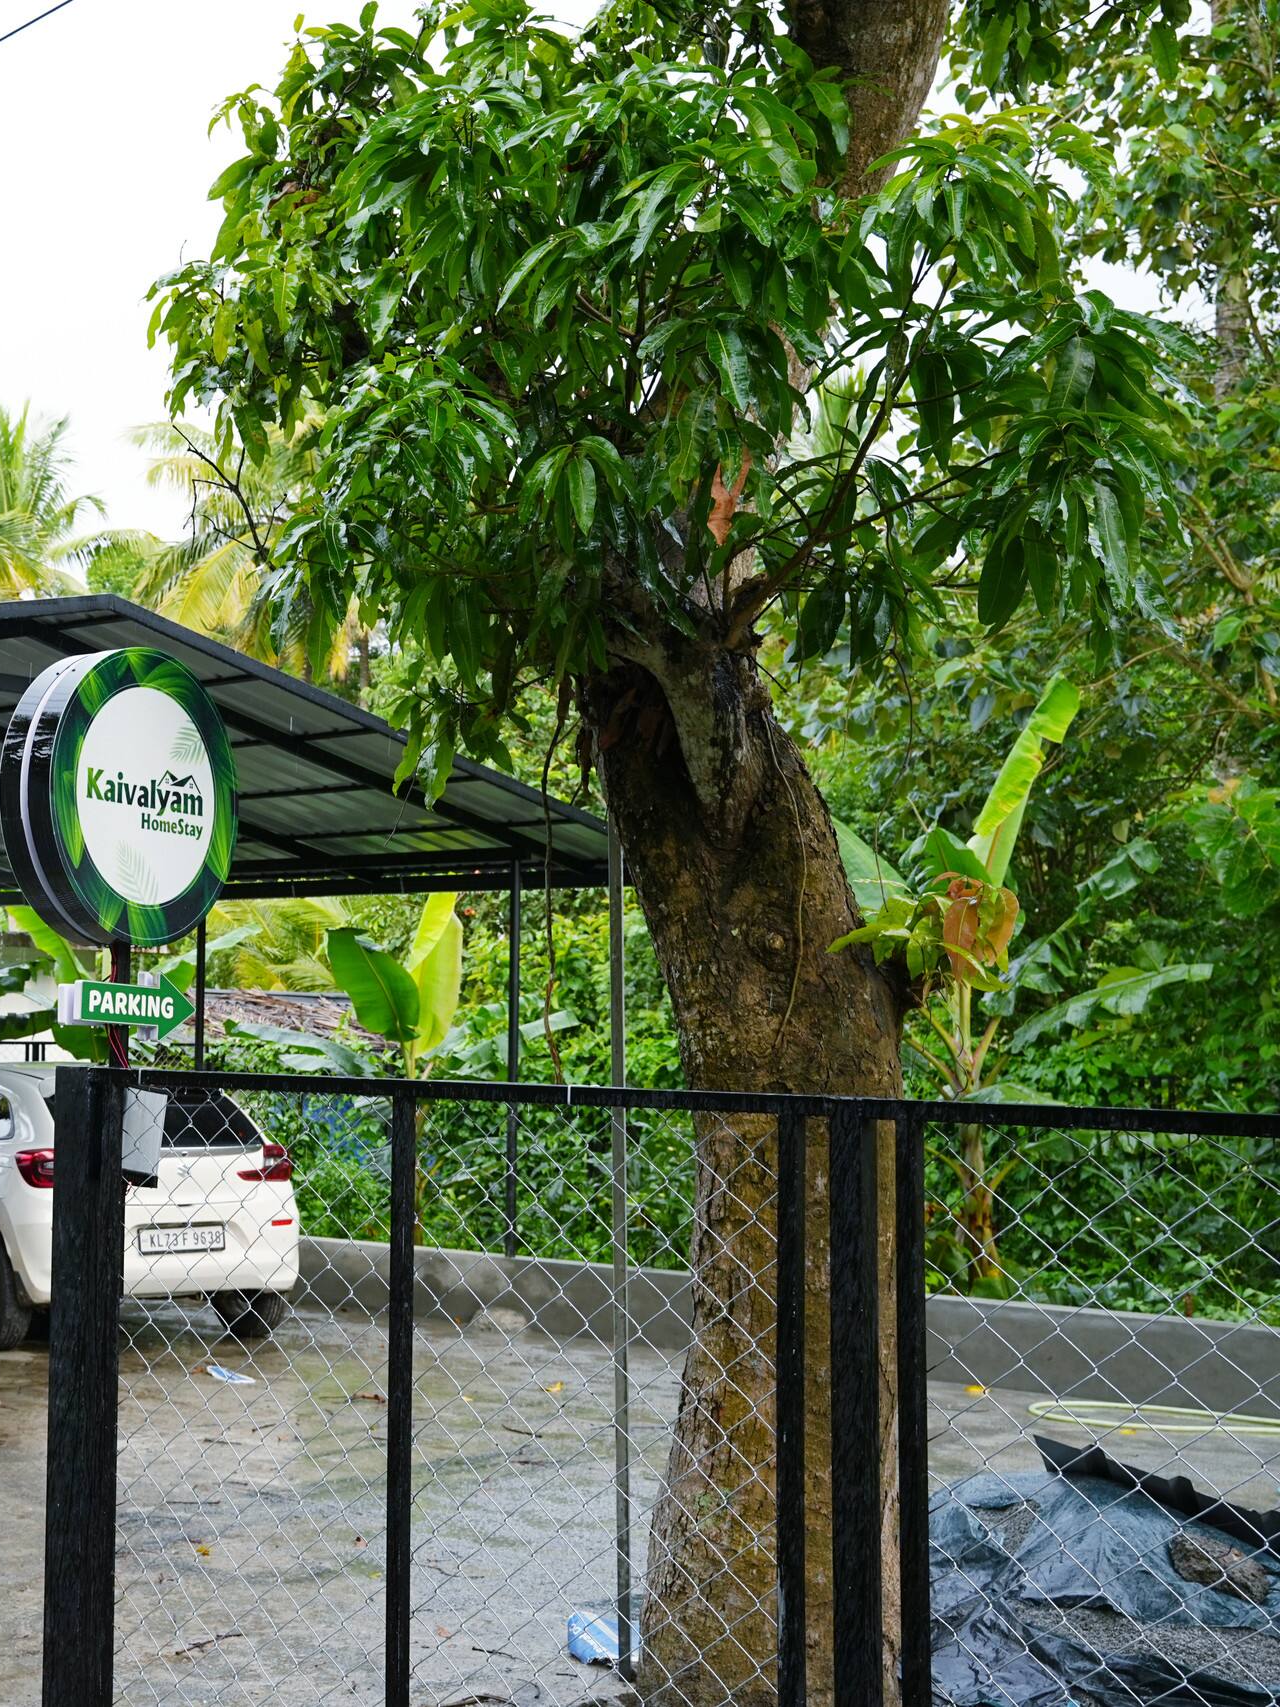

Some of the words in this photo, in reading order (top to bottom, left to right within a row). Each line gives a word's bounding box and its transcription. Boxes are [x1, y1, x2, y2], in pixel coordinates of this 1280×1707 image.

[86, 767, 203, 817] Kaivalyam
[141, 813, 203, 841] HomeStay
[89, 990, 174, 1019] PARKING
